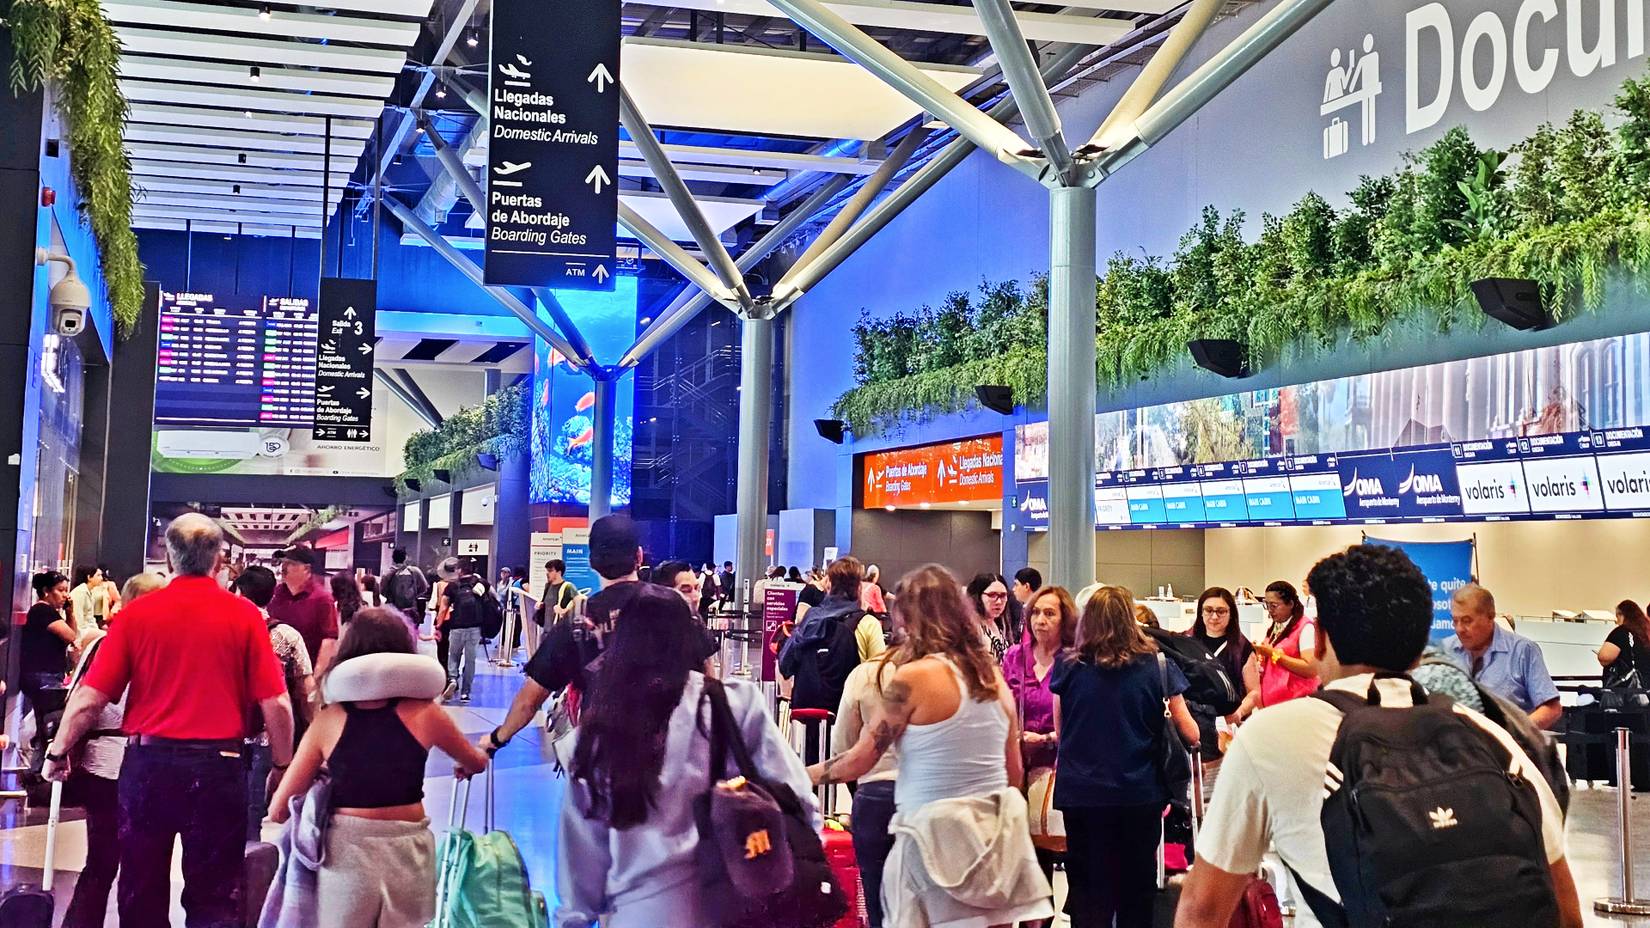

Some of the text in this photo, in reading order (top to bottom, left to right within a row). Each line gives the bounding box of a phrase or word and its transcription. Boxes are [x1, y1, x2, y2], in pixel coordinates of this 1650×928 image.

[1405, 0, 1650, 135] Docu
[494, 88, 554, 107] Llegadas
[494, 105, 566, 124] Nacionales
[493, 124, 599, 145] Domestic Arrivals
[491, 191, 543, 208] Puertas
[491, 209, 570, 229] de Abordaje
[491, 226, 587, 246] Boarding Gates
[565, 268, 585, 277] ATM
[332, 320, 351, 328] Salida
[354, 320, 363, 336] 3
[318, 354, 346, 363] Llegadas
[318, 361, 351, 370] Nacionales
[318, 370, 366, 379] Domestic Arrivals
[316, 399, 340, 407] Puertas
[325, 407, 352, 416] Abordaje
[316, 413, 359, 423] Boarding Gates
[885, 465, 900, 478] Puertas
[908, 462, 928, 478] Abordaje
[960, 455, 981, 473] Llegadas
[960, 471, 994, 486] Domestic Arrivals
[1356, 478, 1384, 496] OMA
[1413, 474, 1443, 493] OMA
[1532, 474, 1576, 498] volaris
[1607, 470, 1650, 494] volari
[1465, 478, 1505, 500] volaris
